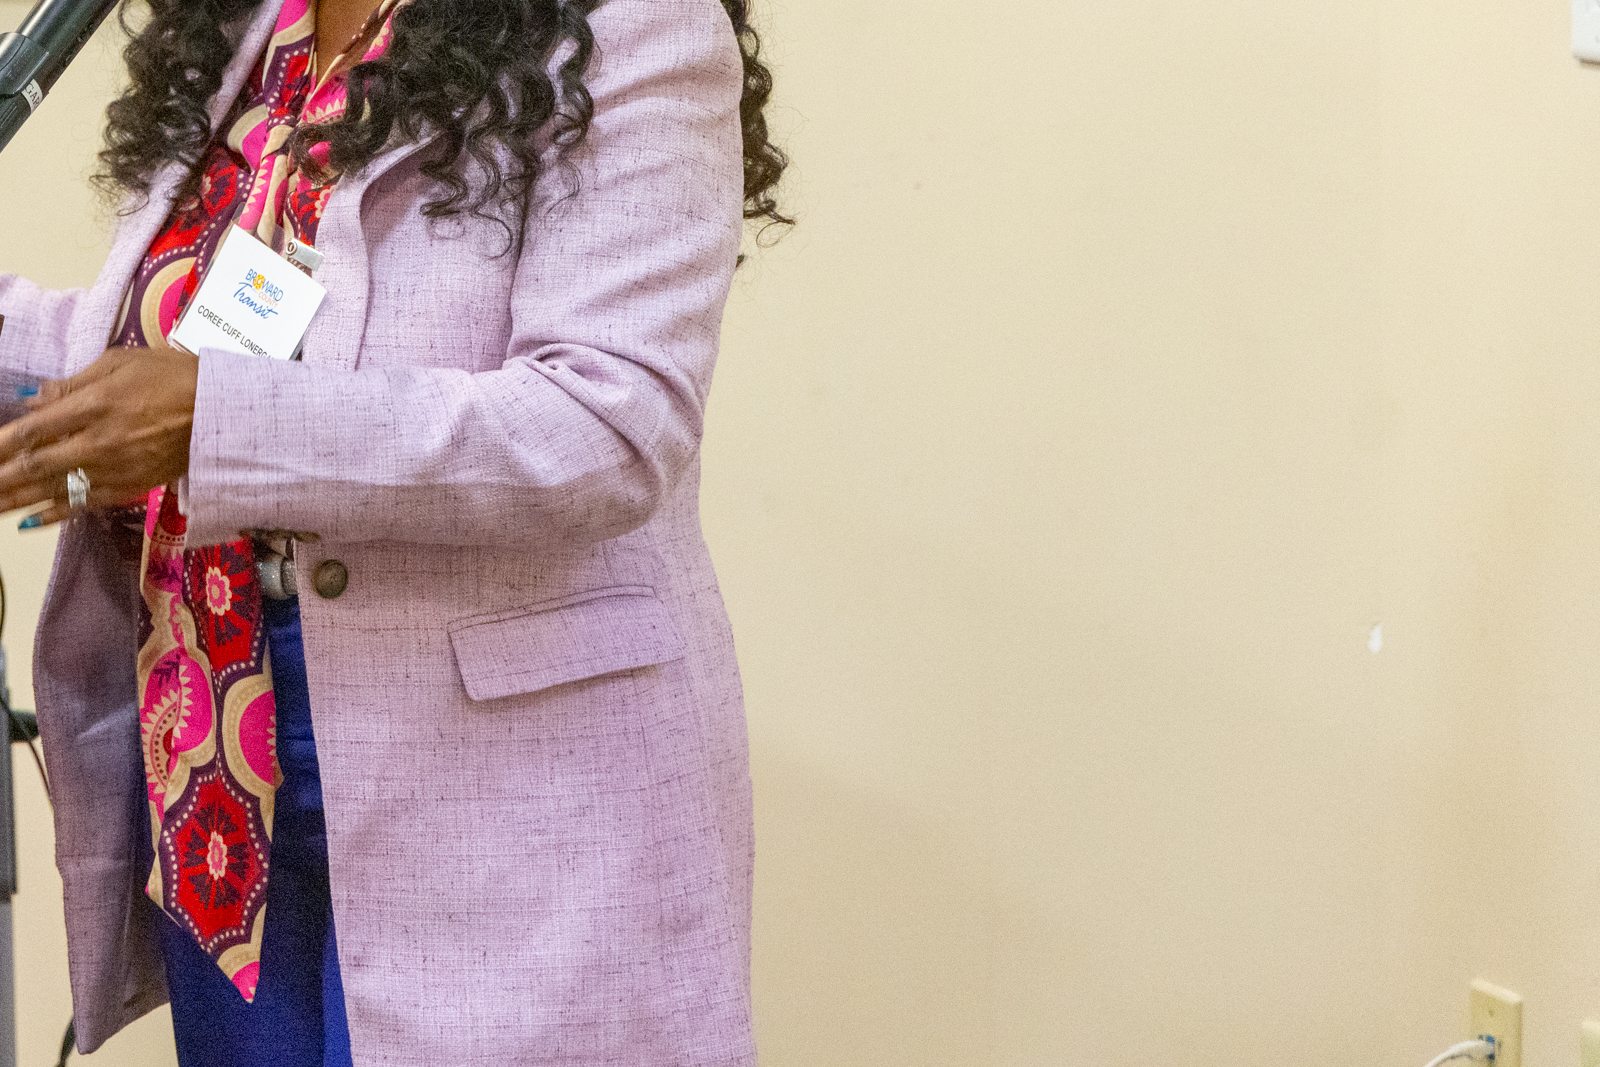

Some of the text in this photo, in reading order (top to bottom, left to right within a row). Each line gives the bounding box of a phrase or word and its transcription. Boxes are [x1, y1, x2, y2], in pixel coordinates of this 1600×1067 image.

[233, 281, 279, 319] Transit
[245, 268, 284, 302] BROWARD
[258, 291, 278, 308] COUNTY
[197, 305, 223, 328] COREE
[222, 322, 242, 340] CUFF
